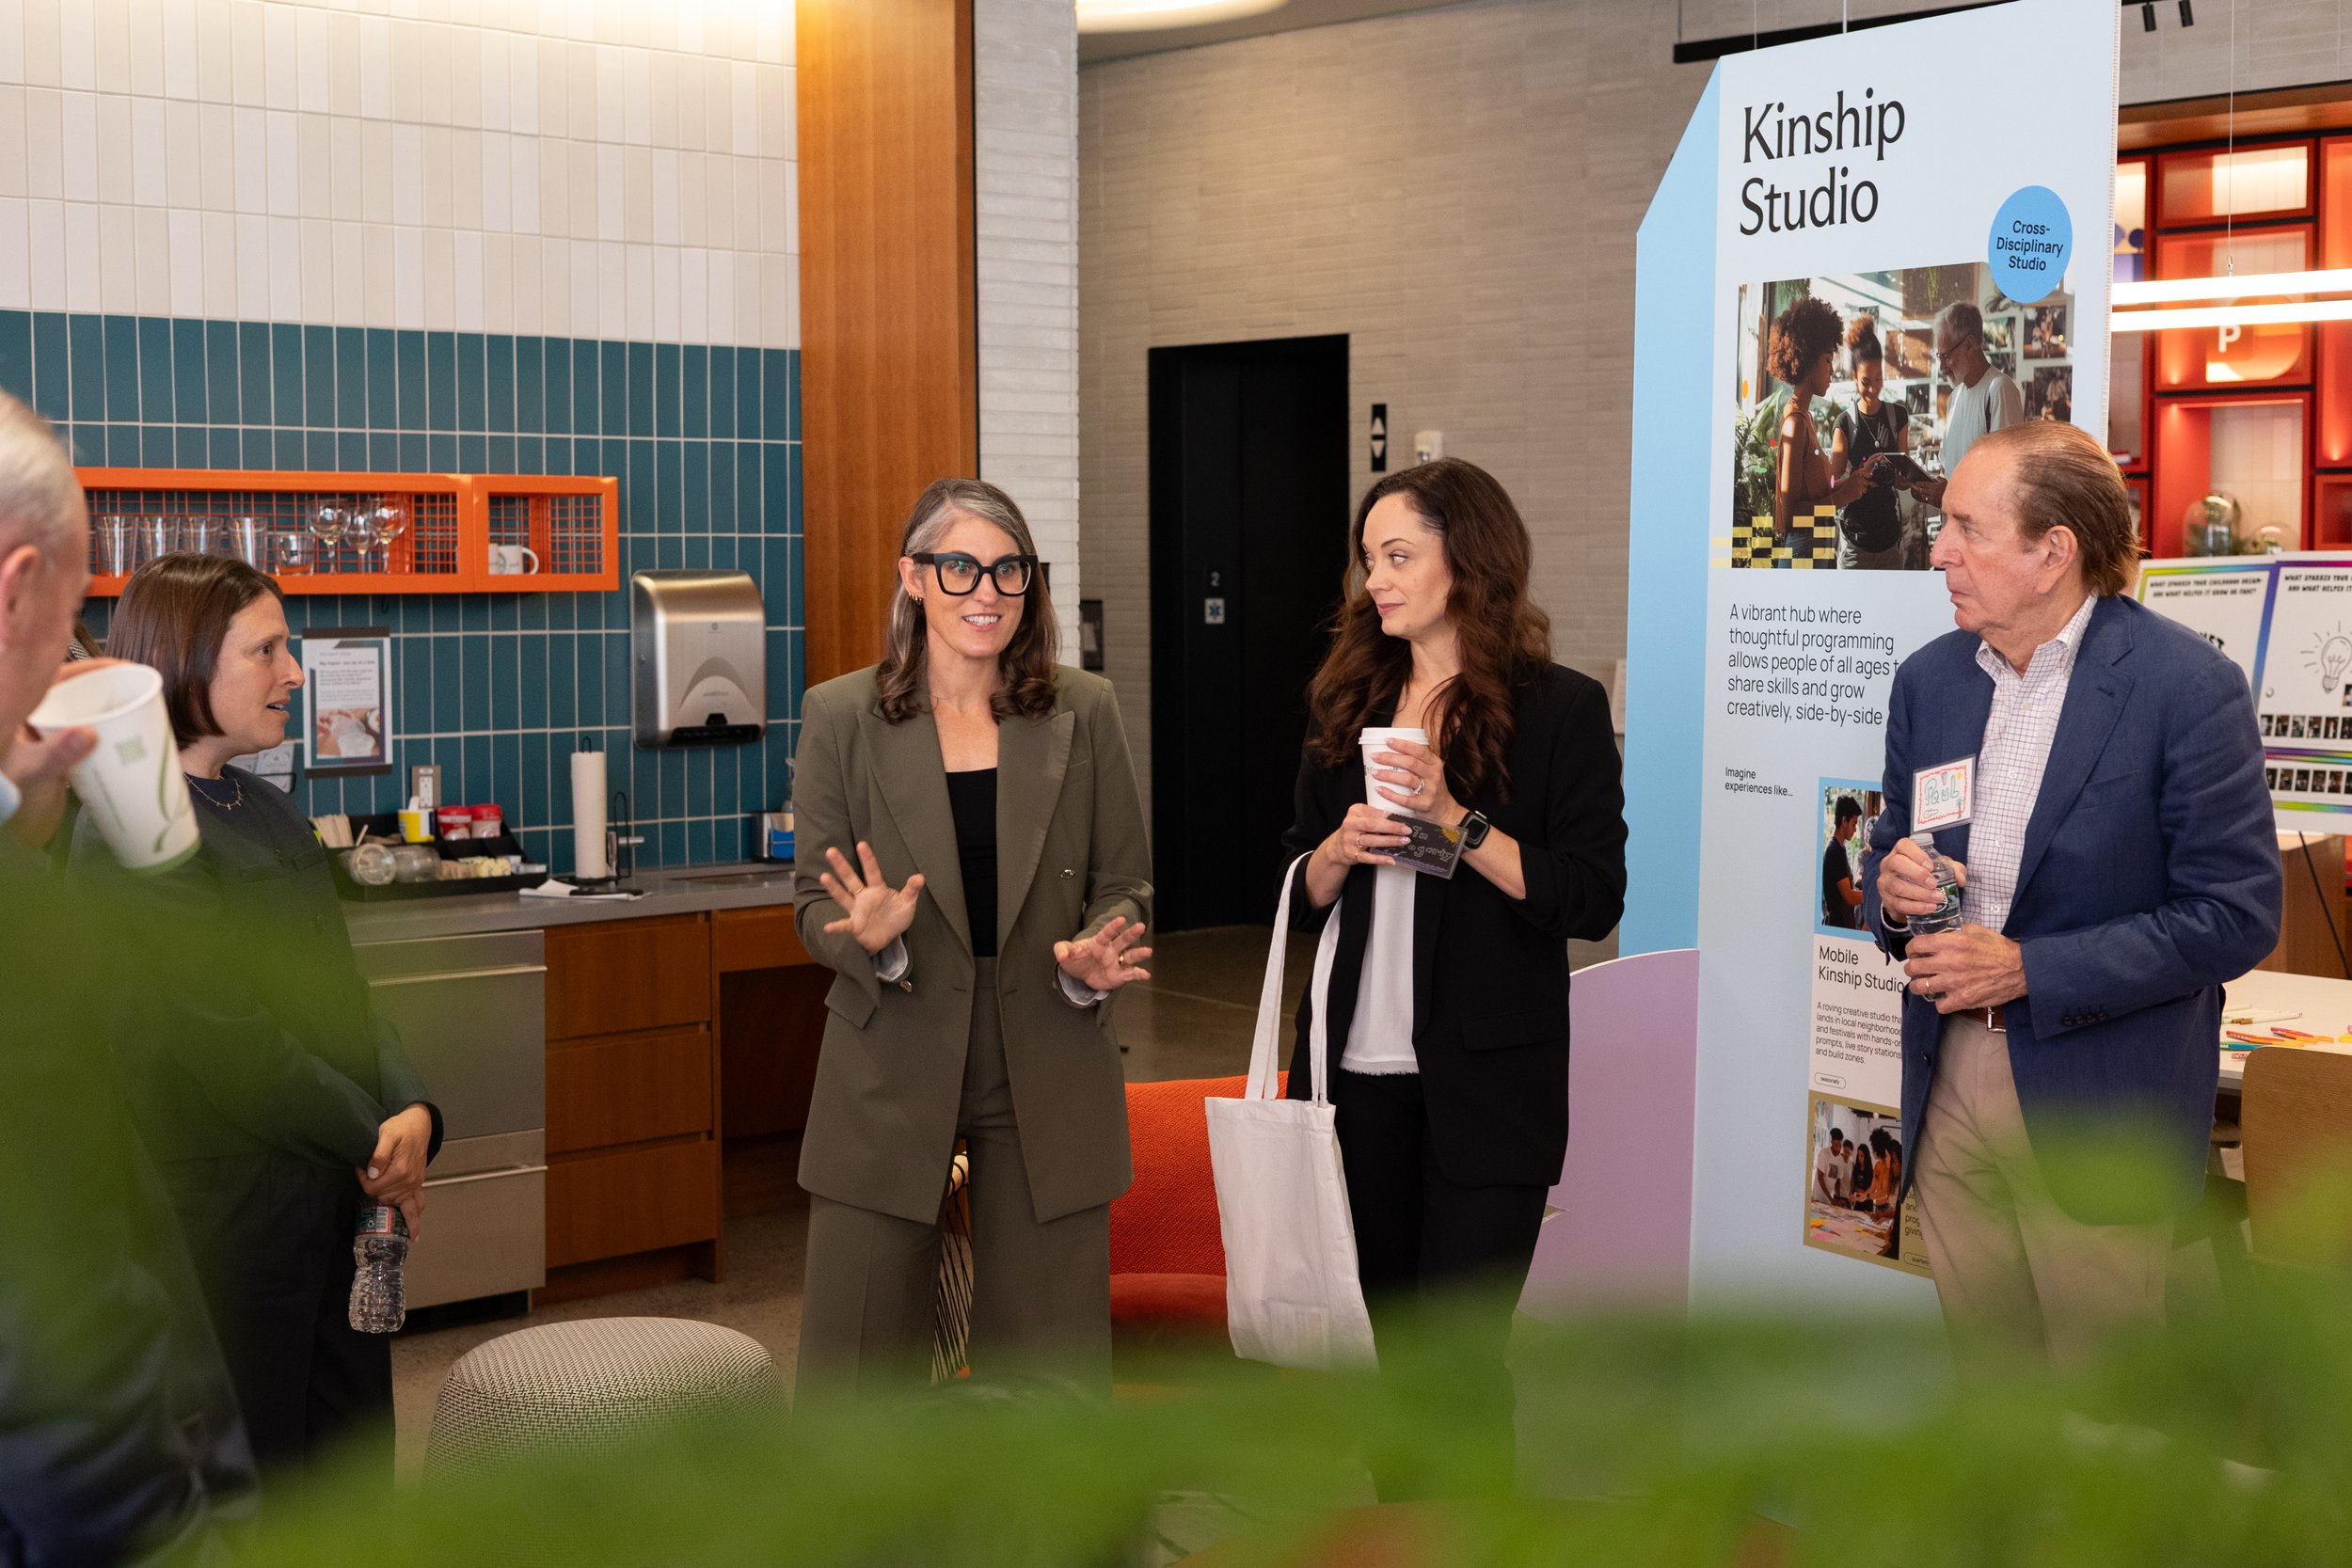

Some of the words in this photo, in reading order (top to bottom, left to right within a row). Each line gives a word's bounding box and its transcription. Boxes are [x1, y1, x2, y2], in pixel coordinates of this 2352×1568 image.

[1743, 87, 1905, 163] Kinship
[1740, 166, 1878, 235] Studio
[2013, 220, 2050, 235] Cross-
[1996, 237, 2063, 258] Disciplinary
[2009, 256, 2046, 271] Studio
[1729, 604, 1739, 621] A
[1741, 605, 1788, 623] vibrant
[1790, 606, 1816, 623] hub
[1819, 607, 1862, 625] where
[1729, 628, 1799, 650] thoughtful
[1803, 633, 1894, 656] programming
[1728, 651, 1769, 669] allows
[1772, 655, 1817, 675] people
[1820, 656, 1836, 673] of
[1836, 657, 1852, 673] all
[1855, 660, 1890, 680] ages
[1727, 675, 1764, 693] share
[1767, 677, 1800, 695] skills
[1803, 680, 1827, 697] and
[1831, 684, 1866, 703] grow
[1727, 700, 1792, 723] creatively,
[1796, 704, 1883, 727] side-by-side
[1725, 767, 1756, 781] Imagine
[1724, 782, 1772, 796] experiences
[1820, 944, 1859, 965] Mobile
[1819, 966, 1862, 990] Kinship
[1865, 973, 1905, 993] Studio
[1817, 1002, 1822, 1010] A
[1822, 1004, 1842, 1016] roving
[1843, 1007, 1869, 1019] creative
[1870, 1010, 1891, 1022] studio
[1892, 1015, 1902, 1024] tha
[1817, 1013, 1834, 1023] lands
[1835, 1016, 1841, 1024] in
[1842, 1017, 1856, 1028] local
[1817, 1025, 1829, 1034] and
[1829, 1026, 1856, 1039] festivals
[1857, 1033, 1870, 1042] with
[1816, 1037, 1844, 1050] prompts,
[1845, 1040, 1856, 1051] live
[1857, 1043, 1874, 1056] story
[1816, 1048, 1828, 1057] and
[1829, 1049, 1844, 1060] build
